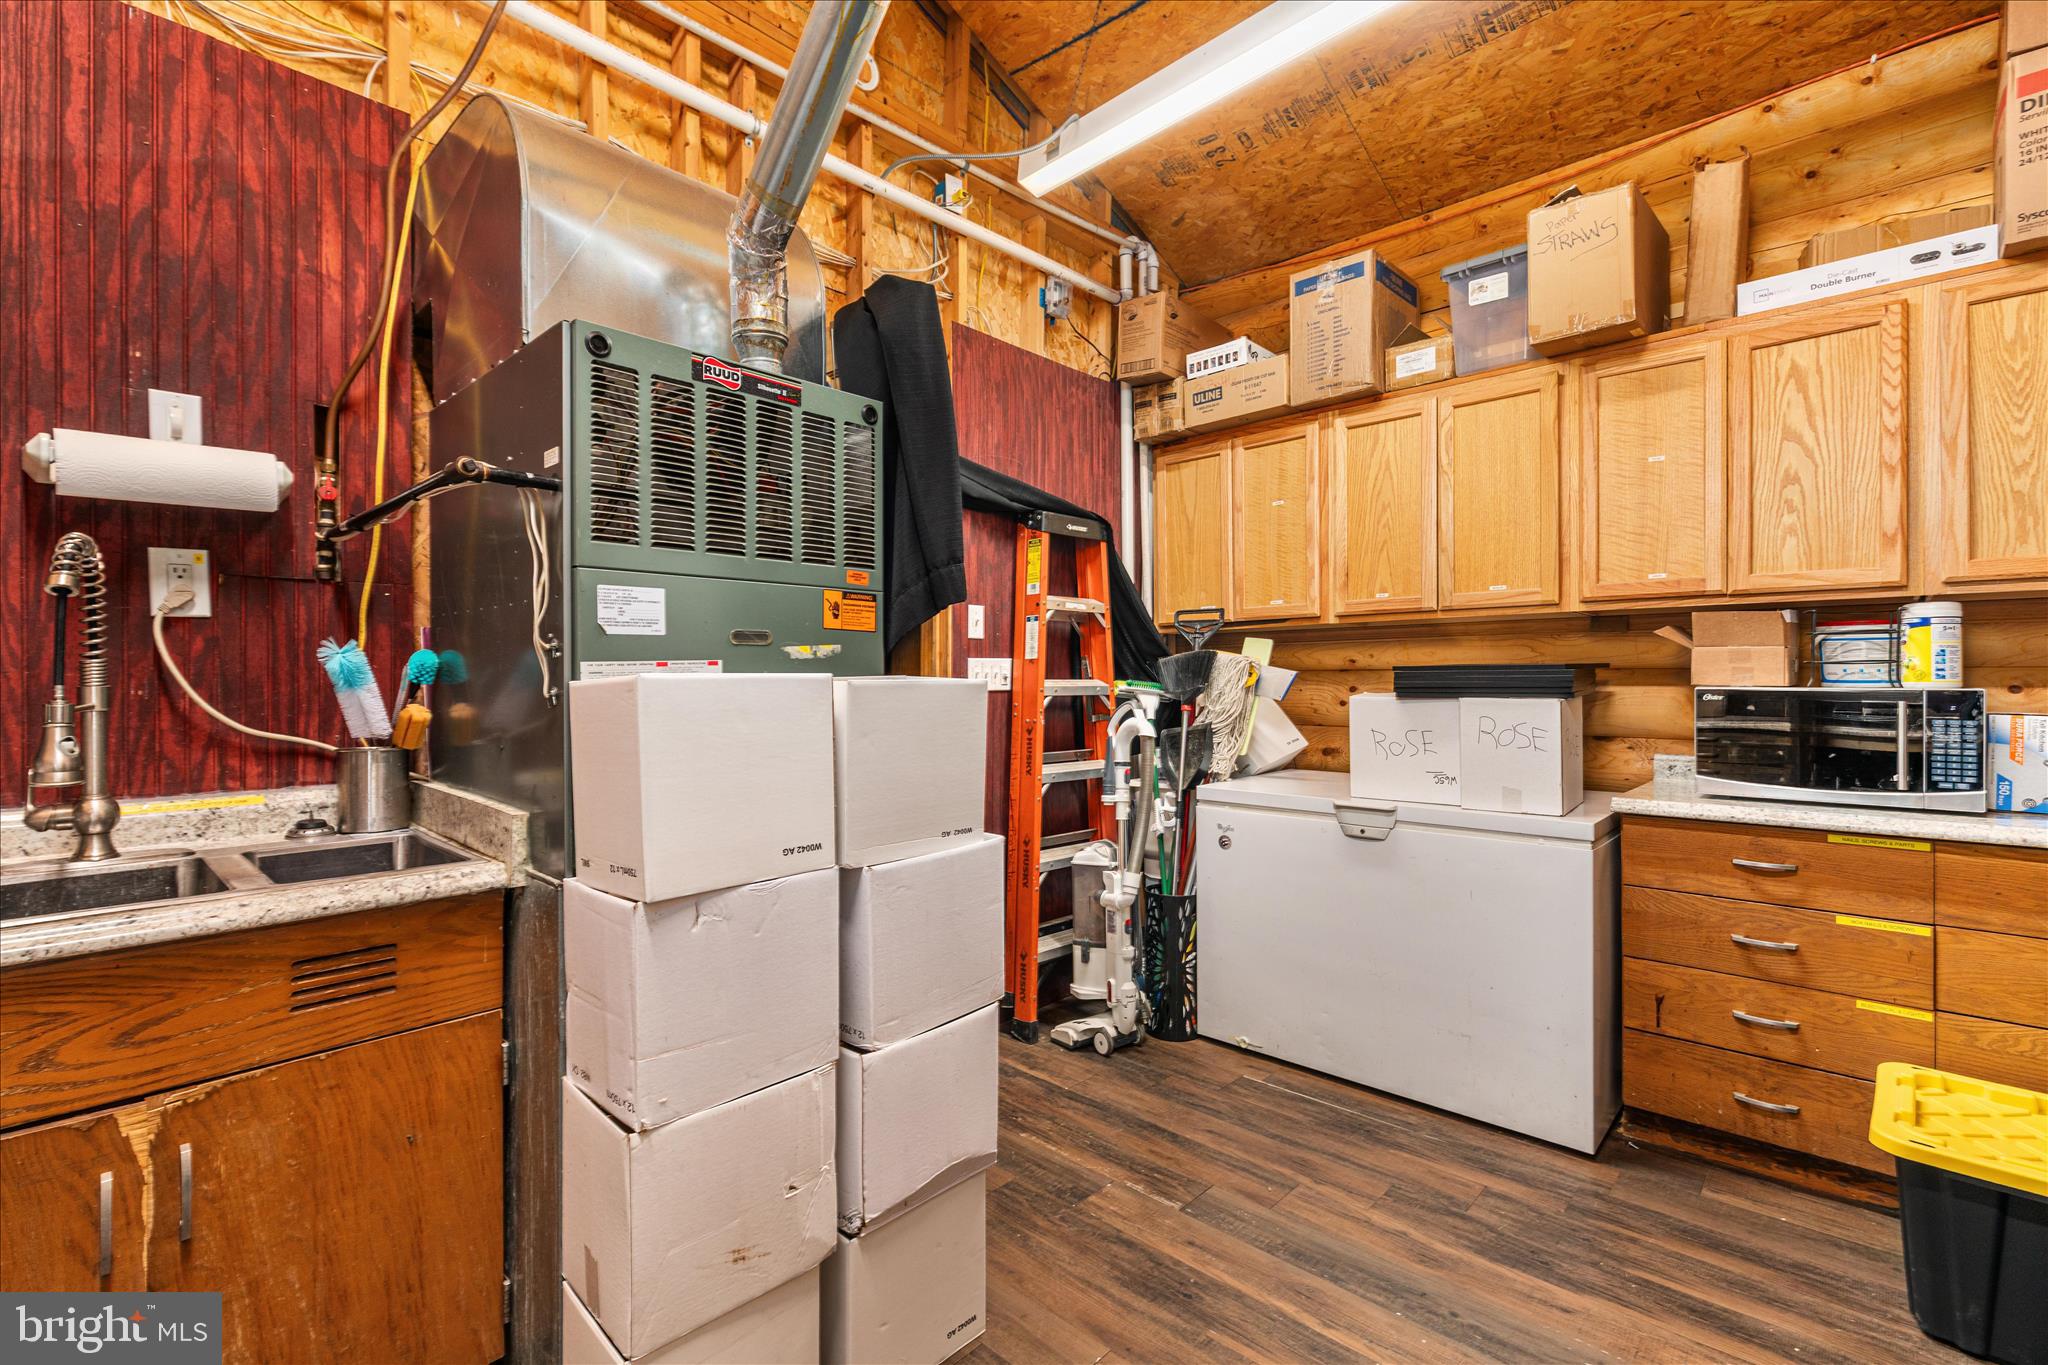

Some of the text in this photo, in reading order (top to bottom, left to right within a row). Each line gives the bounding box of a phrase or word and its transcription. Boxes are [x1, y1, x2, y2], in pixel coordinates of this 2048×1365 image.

[1533, 216, 1619, 260] STRAWS
[1809, 278, 1843, 292] Double
[1845, 269, 1877, 285] Burner
[703, 364, 740, 382] RUUD
[1194, 389, 1222, 405] ULINE
[2015, 717, 2025, 762] DURA FORCE
[1025, 736, 1033, 777] HUSKY
[1998, 780, 2011, 796] 150
[782, 846, 796, 857] AG
[1022, 849, 1031, 889] HUSKY
[1019, 962, 1027, 1004] HUSKY
[946, 1327, 957, 1340] AG
